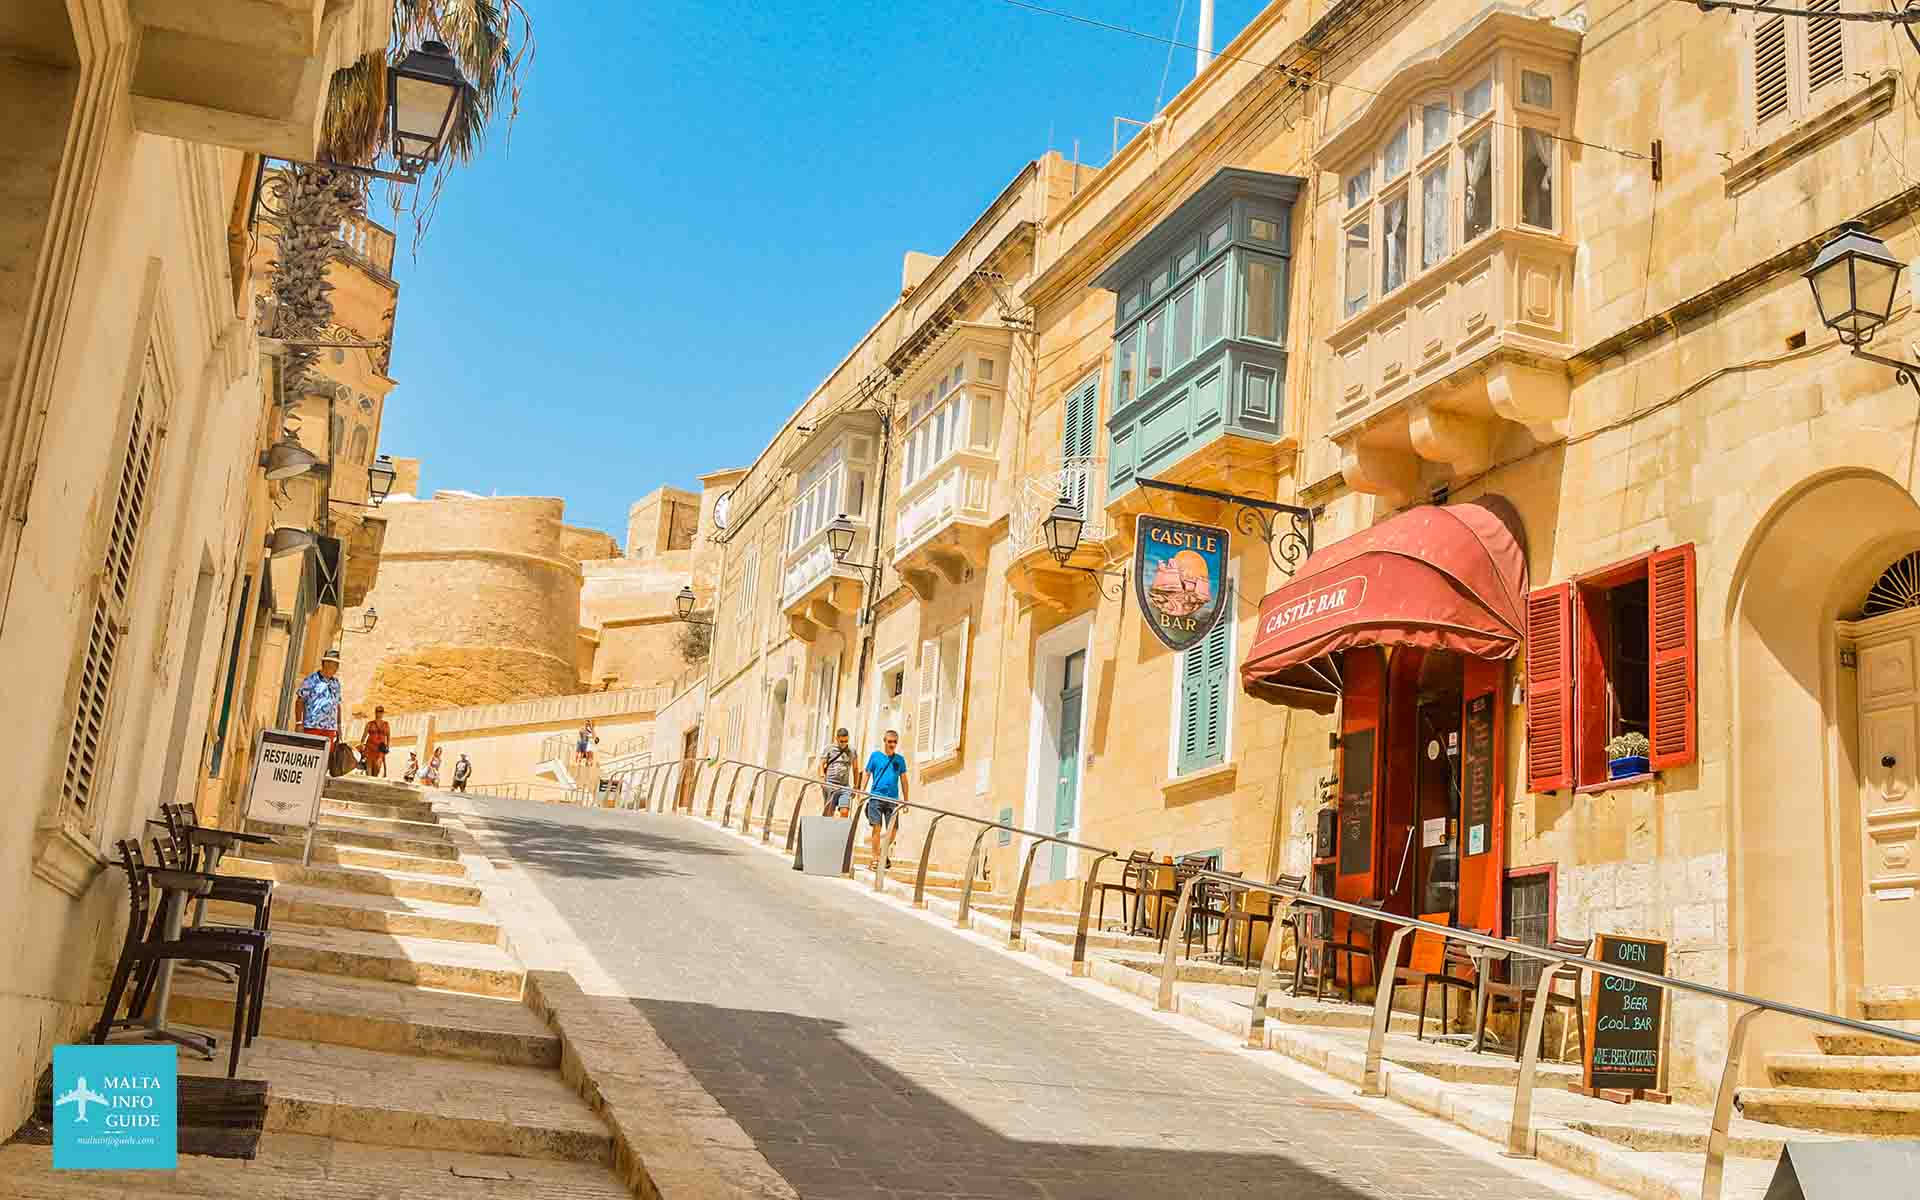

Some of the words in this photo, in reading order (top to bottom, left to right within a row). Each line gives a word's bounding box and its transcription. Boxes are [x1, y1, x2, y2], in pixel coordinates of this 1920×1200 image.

[1151, 528, 1217, 553] CASTLE
[1265, 598, 1316, 634] CASTLE
[1316, 589, 1348, 614] BAR
[1160, 614, 1197, 632] BAR
[263, 749, 320, 769] RESTAURANT
[273, 768, 303, 784] INSIDE
[1618, 943, 1647, 962] OPEN
[1604, 976, 1636, 992] COLD
[1623, 994, 1648, 1011] BEER
[1633, 1016, 1653, 1031] BAR
